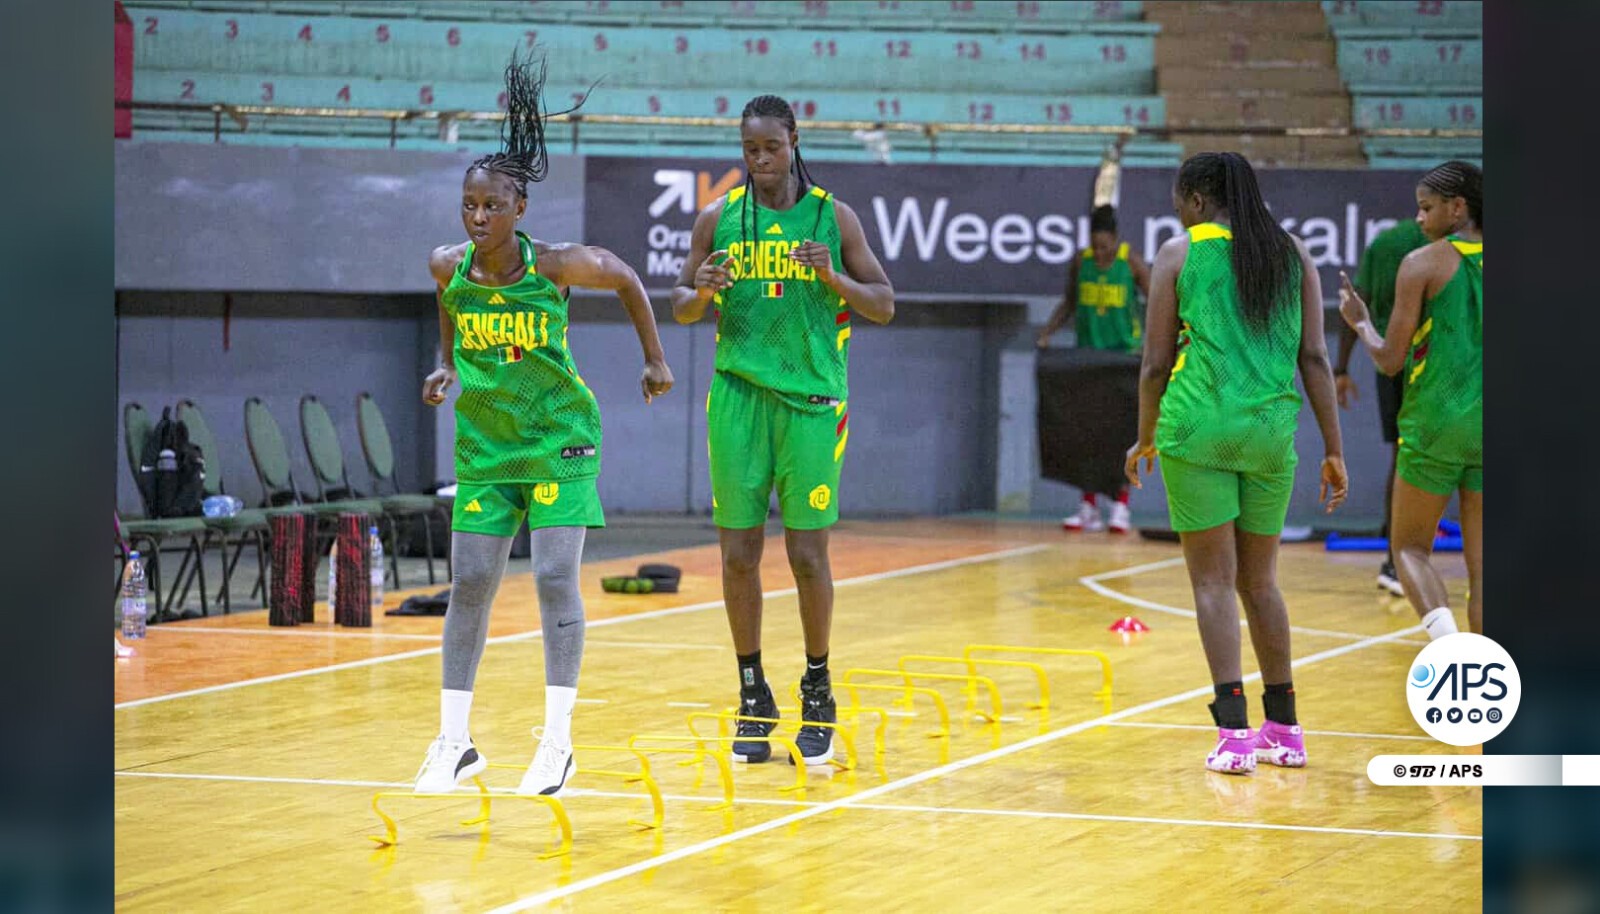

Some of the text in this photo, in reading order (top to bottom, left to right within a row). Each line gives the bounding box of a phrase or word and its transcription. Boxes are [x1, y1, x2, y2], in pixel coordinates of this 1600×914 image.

[144, 17, 159, 35] 2
[225, 19, 239, 40] 3
[298, 23, 313, 42] 4
[376, 24, 390, 43] 5
[447, 27, 461, 47] 6
[524, 30, 538, 49] 7
[744, 38, 769, 55] 10
[813, 39, 837, 57] 11
[886, 40, 911, 59] 12
[956, 41, 981, 61] 13
[1019, 42, 1046, 61] 14
[1437, 44, 1462, 63] 17
[181, 79, 196, 99] 2
[261, 82, 274, 102] 3
[336, 84, 351, 103] 4
[877, 98, 901, 117] 11
[968, 102, 994, 121] 12
[1123, 104, 1149, 123] 14
